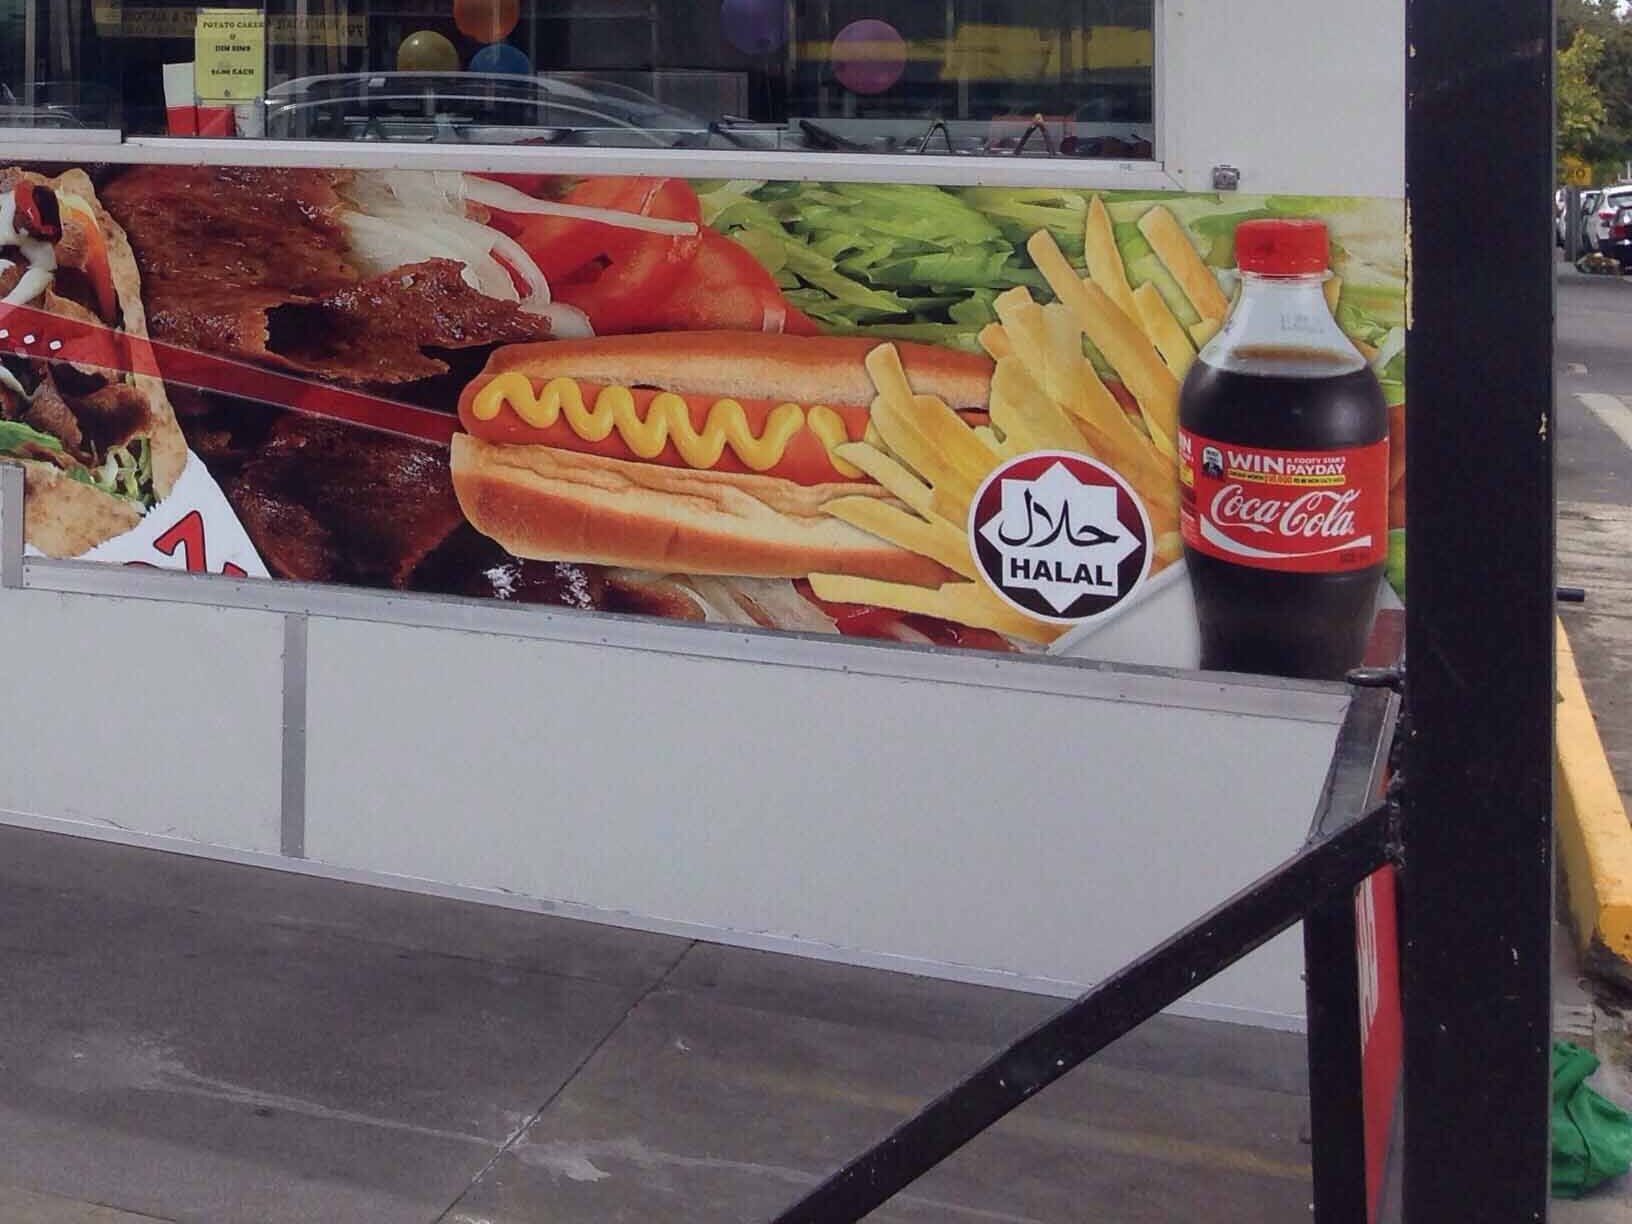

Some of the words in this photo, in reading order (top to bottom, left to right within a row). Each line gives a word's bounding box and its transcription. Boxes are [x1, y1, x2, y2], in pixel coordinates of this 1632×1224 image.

[202, 21, 235, 29] POTATO
[1227, 450, 1284, 474] WIN
[1286, 463, 1346, 476] PAYDAY
[997, 487, 1121, 548] حلال
[1210, 484, 1362, 537] Coca-Cola
[1010, 556, 1114, 588] HALAL
